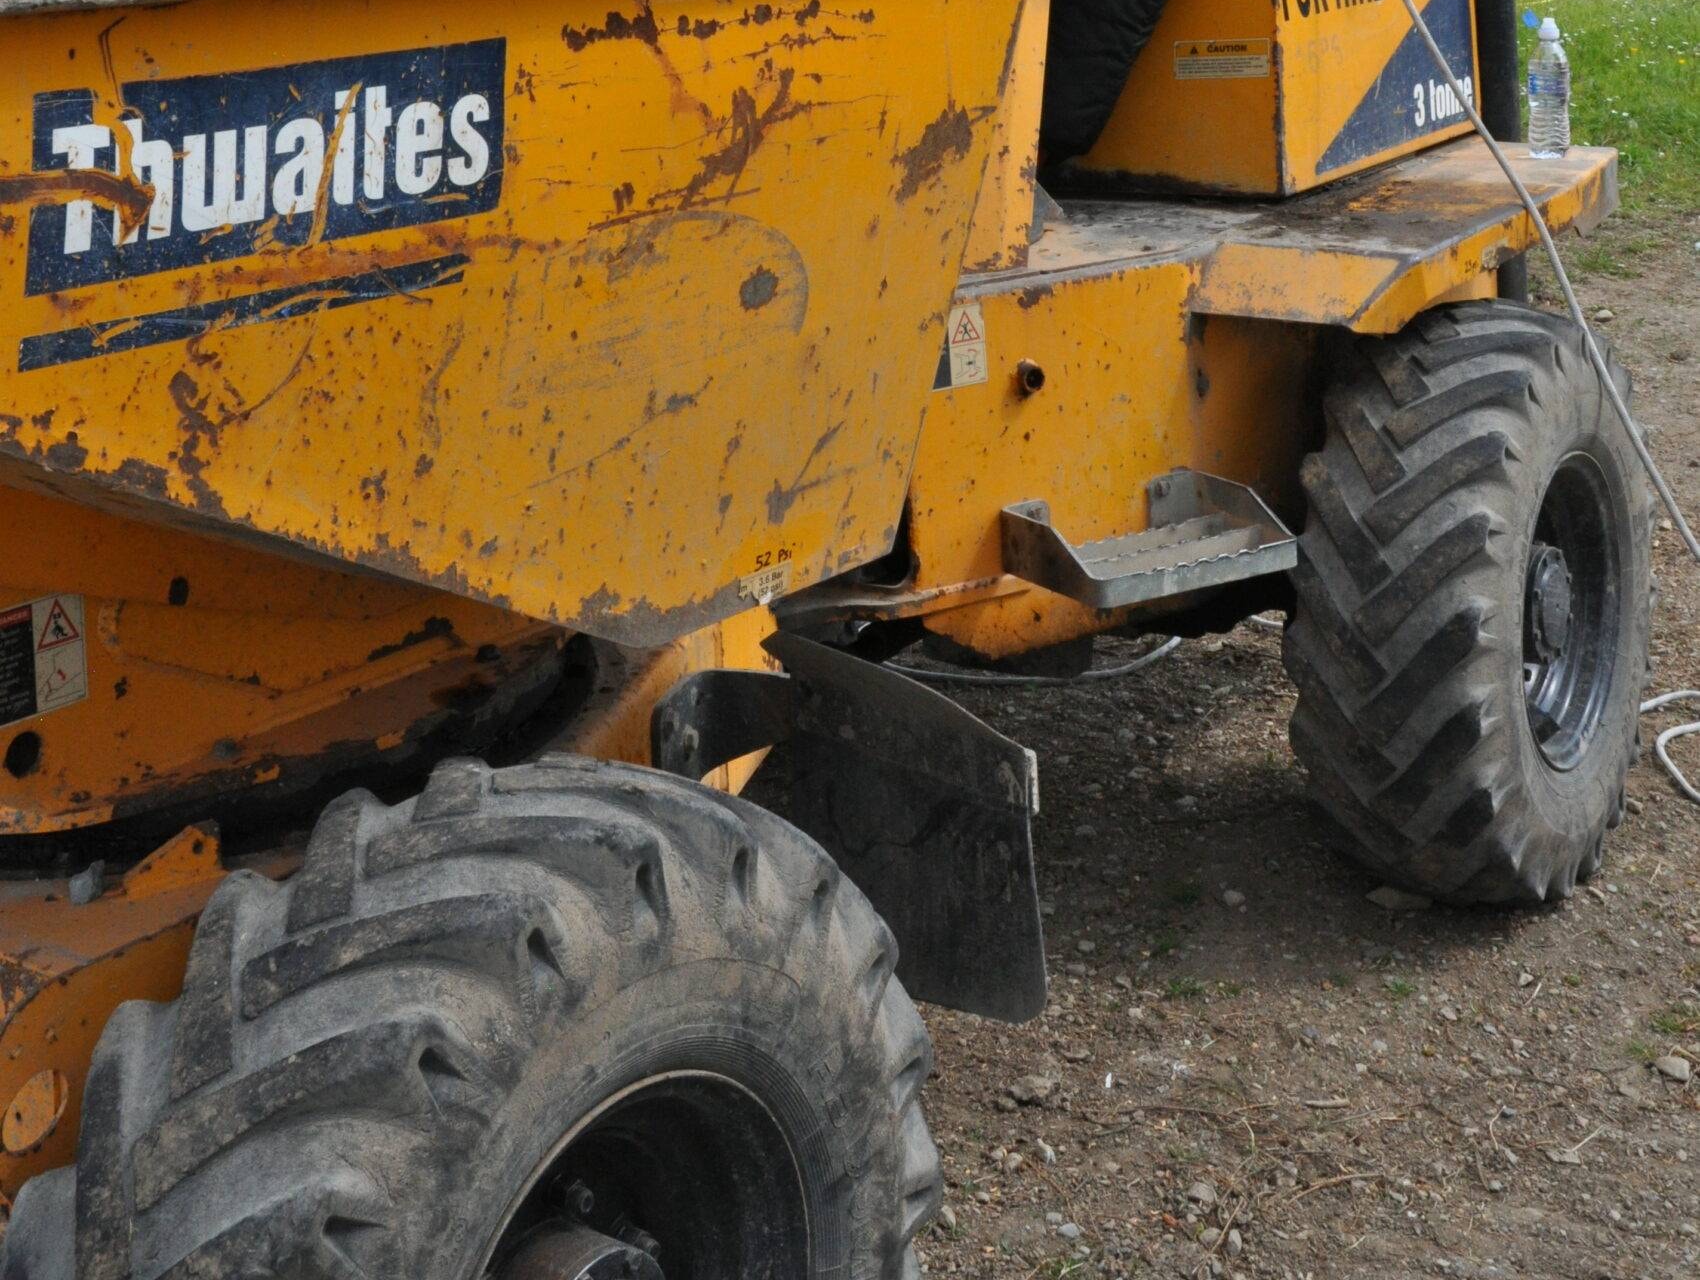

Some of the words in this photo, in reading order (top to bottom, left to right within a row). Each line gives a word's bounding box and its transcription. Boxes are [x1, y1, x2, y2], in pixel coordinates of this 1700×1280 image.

[1206, 43, 1248, 54] CAUTION
[1413, 83, 1426, 127] 3
[51, 84, 491, 255] Thwaites
[754, 550, 772, 572] 52
